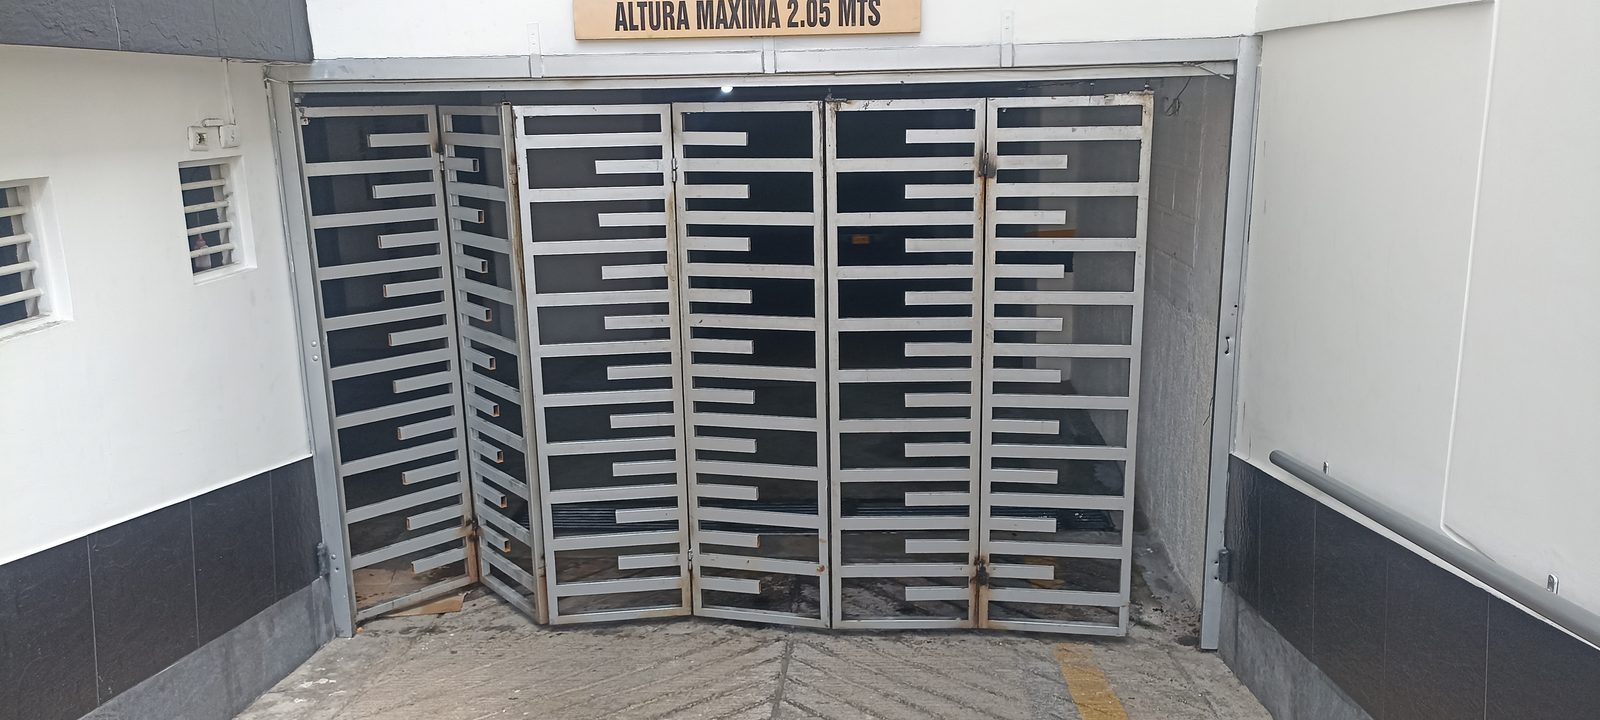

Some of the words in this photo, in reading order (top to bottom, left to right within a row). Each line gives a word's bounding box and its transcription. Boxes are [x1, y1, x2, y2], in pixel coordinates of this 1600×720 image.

[615, 1, 690, 31] ALTURA
[696, 0, 781, 30] MAXIMA
[787, 0, 831, 28] 2.05
[838, 0, 881, 27] MTS
